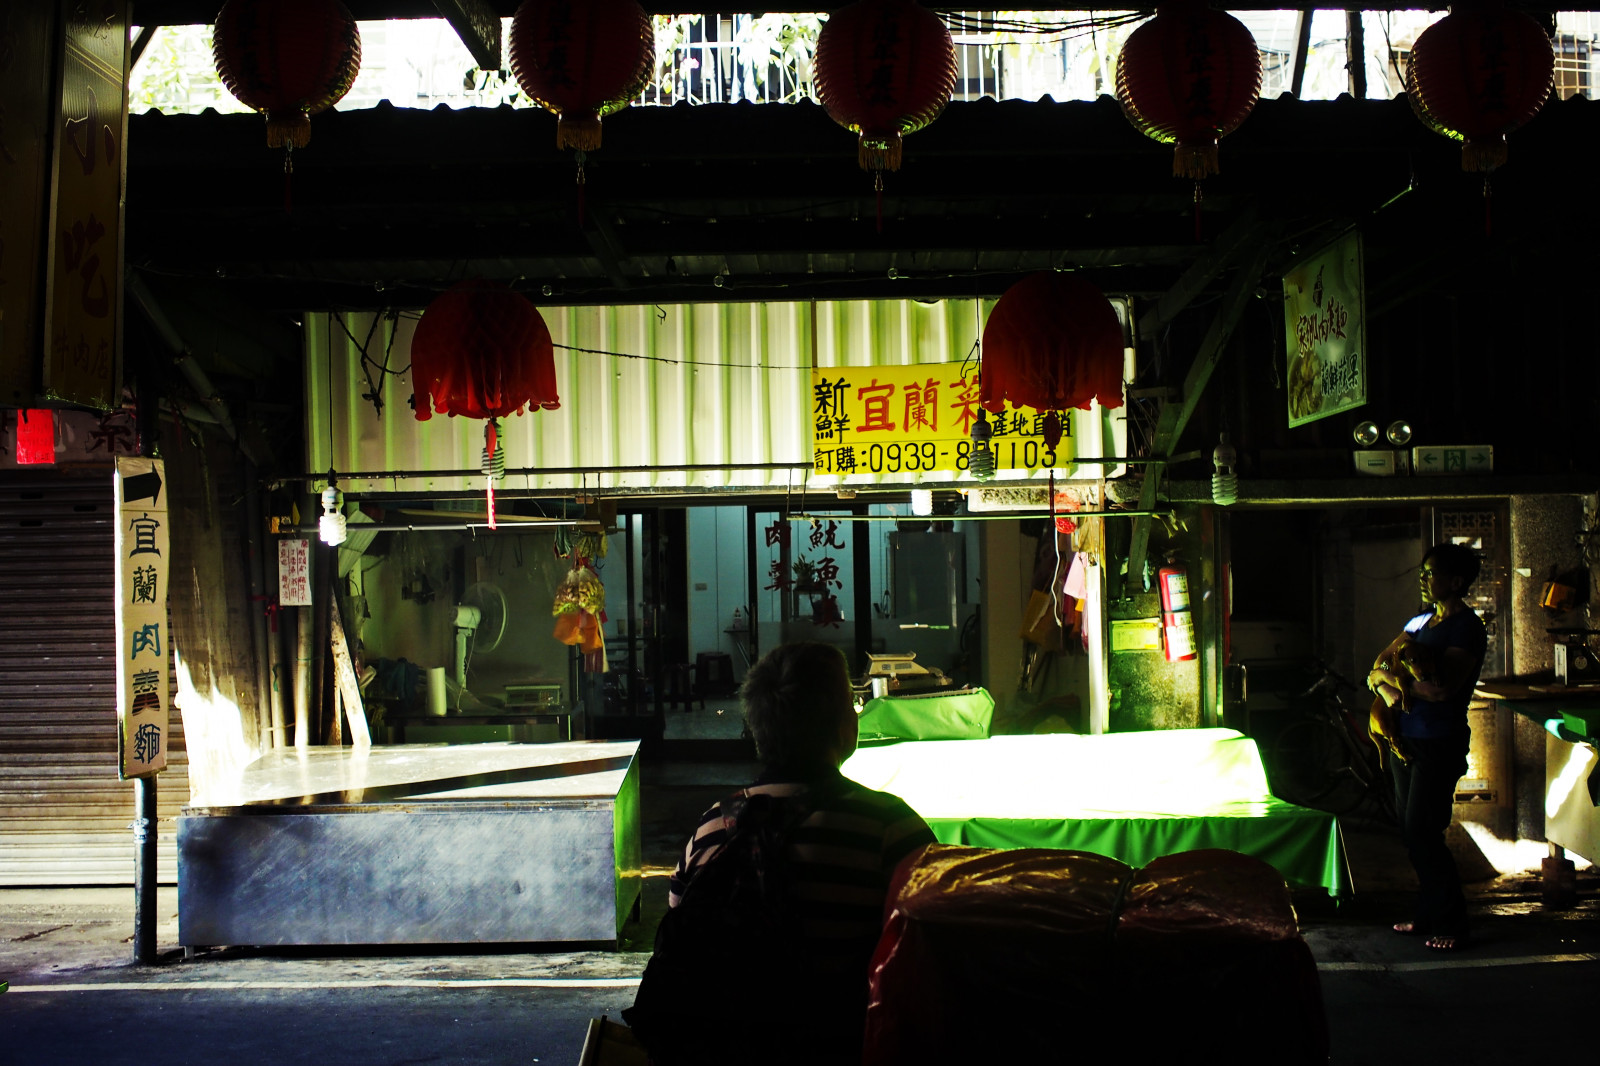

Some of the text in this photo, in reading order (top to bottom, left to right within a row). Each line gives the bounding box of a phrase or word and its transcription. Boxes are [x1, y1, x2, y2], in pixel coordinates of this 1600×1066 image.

[814, 377, 851, 444] 新鮮
[129, 512, 161, 764] 宜蘭肉羹麵
